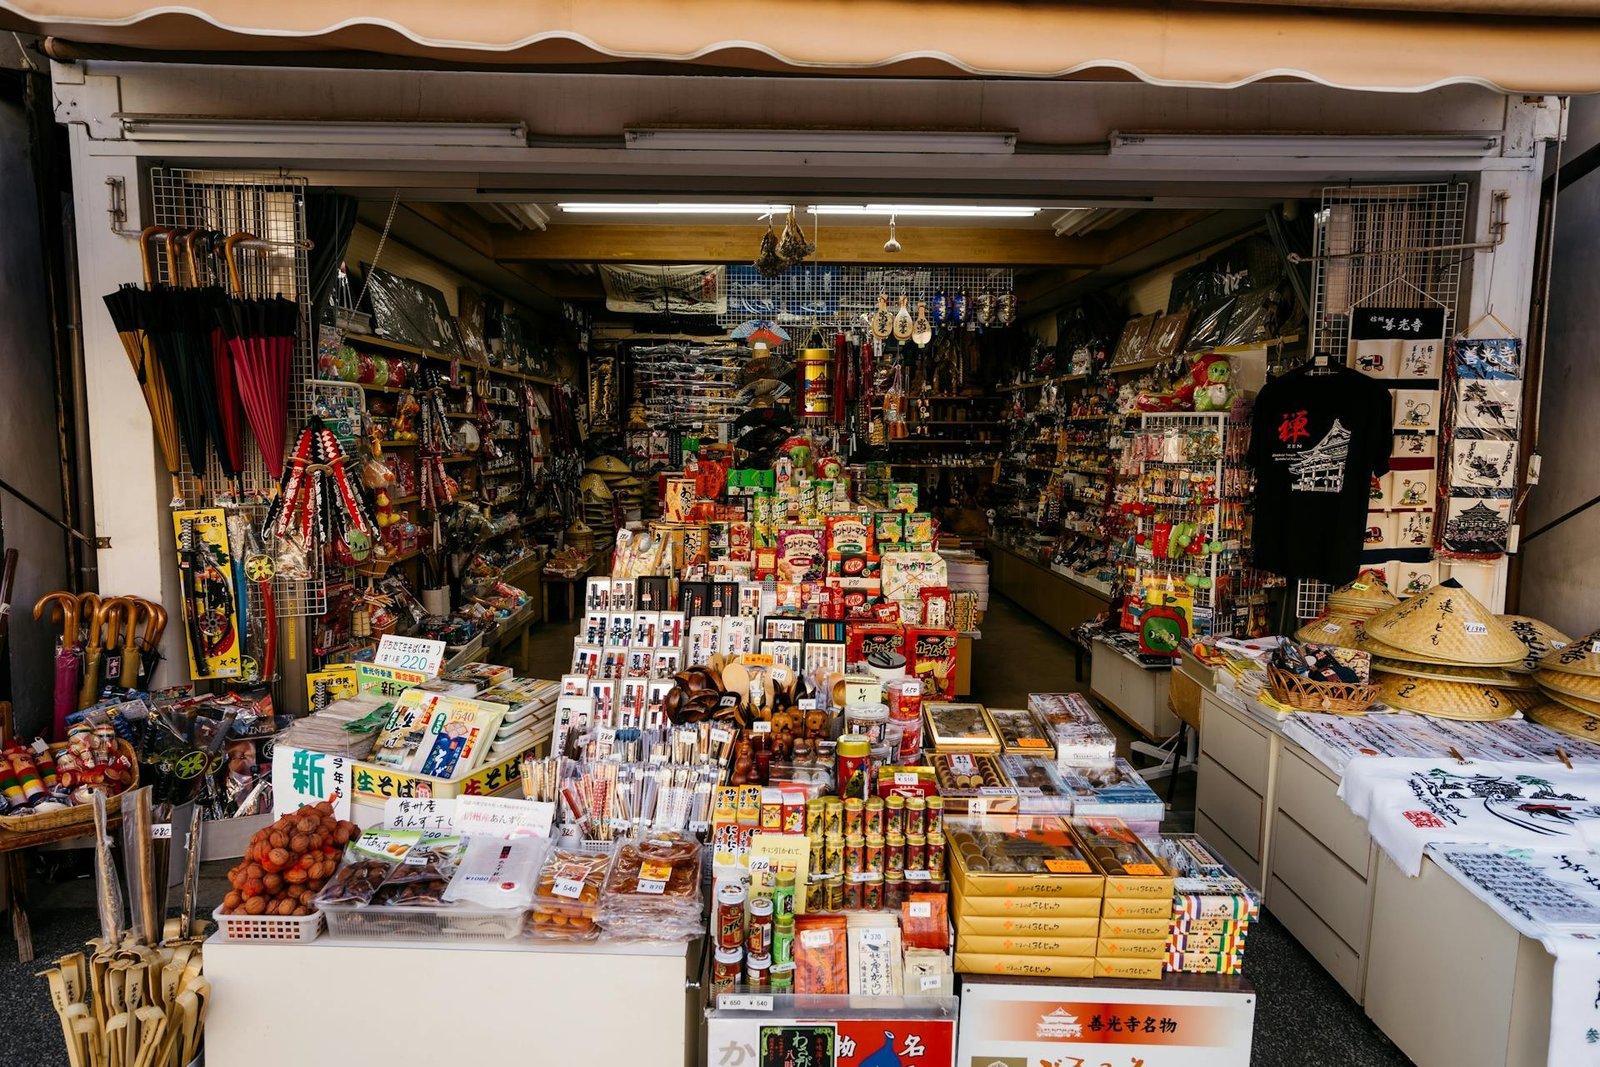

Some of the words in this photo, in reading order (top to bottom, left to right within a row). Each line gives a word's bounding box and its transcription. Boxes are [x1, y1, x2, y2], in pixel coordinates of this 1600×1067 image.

[1383, 318, 1423, 332] 善光寺
[1464, 346, 1515, 364] 善光寺
[832, 528, 868, 537] カントリーマアム
[784, 540, 820, 550] カントリーマアム
[896, 562, 932, 572] じゃがりこ
[916, 640, 950, 656] カラムーチョ
[292, 748, 326, 806] 新
[357, 769, 415, 798] 生そば
[463, 754, 521, 796] 生そば
[1087, 1014, 1178, 1034] 善光寺名物
